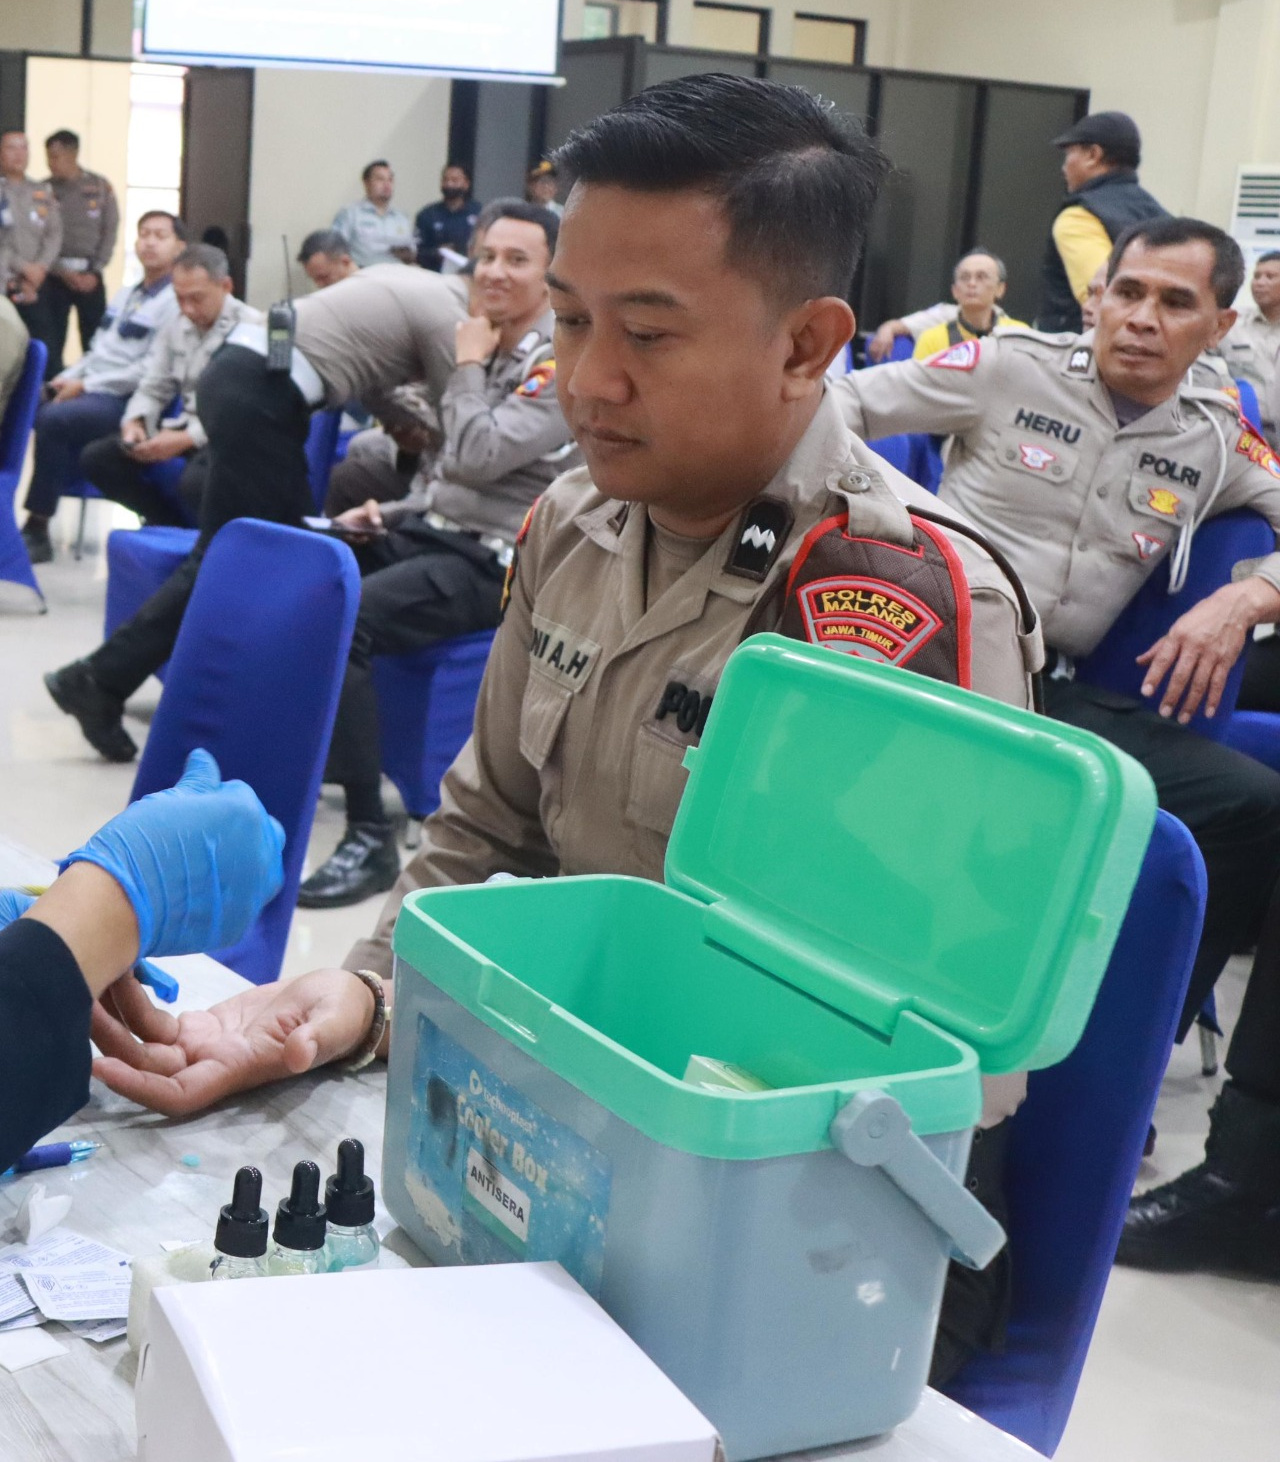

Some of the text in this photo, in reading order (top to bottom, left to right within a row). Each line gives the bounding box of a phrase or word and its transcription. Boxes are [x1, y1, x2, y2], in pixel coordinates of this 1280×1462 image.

[1014, 407, 1082, 444] HERU
[1138, 451, 1202, 488] POLRI
[821, 589, 917, 625] POLRES
[823, 600, 907, 630] MALANG
[824, 625, 894, 650] JAWA TIMUR
[458, 1094, 549, 1194] Cooler Box
[470, 1166, 525, 1223] ANTISERA
